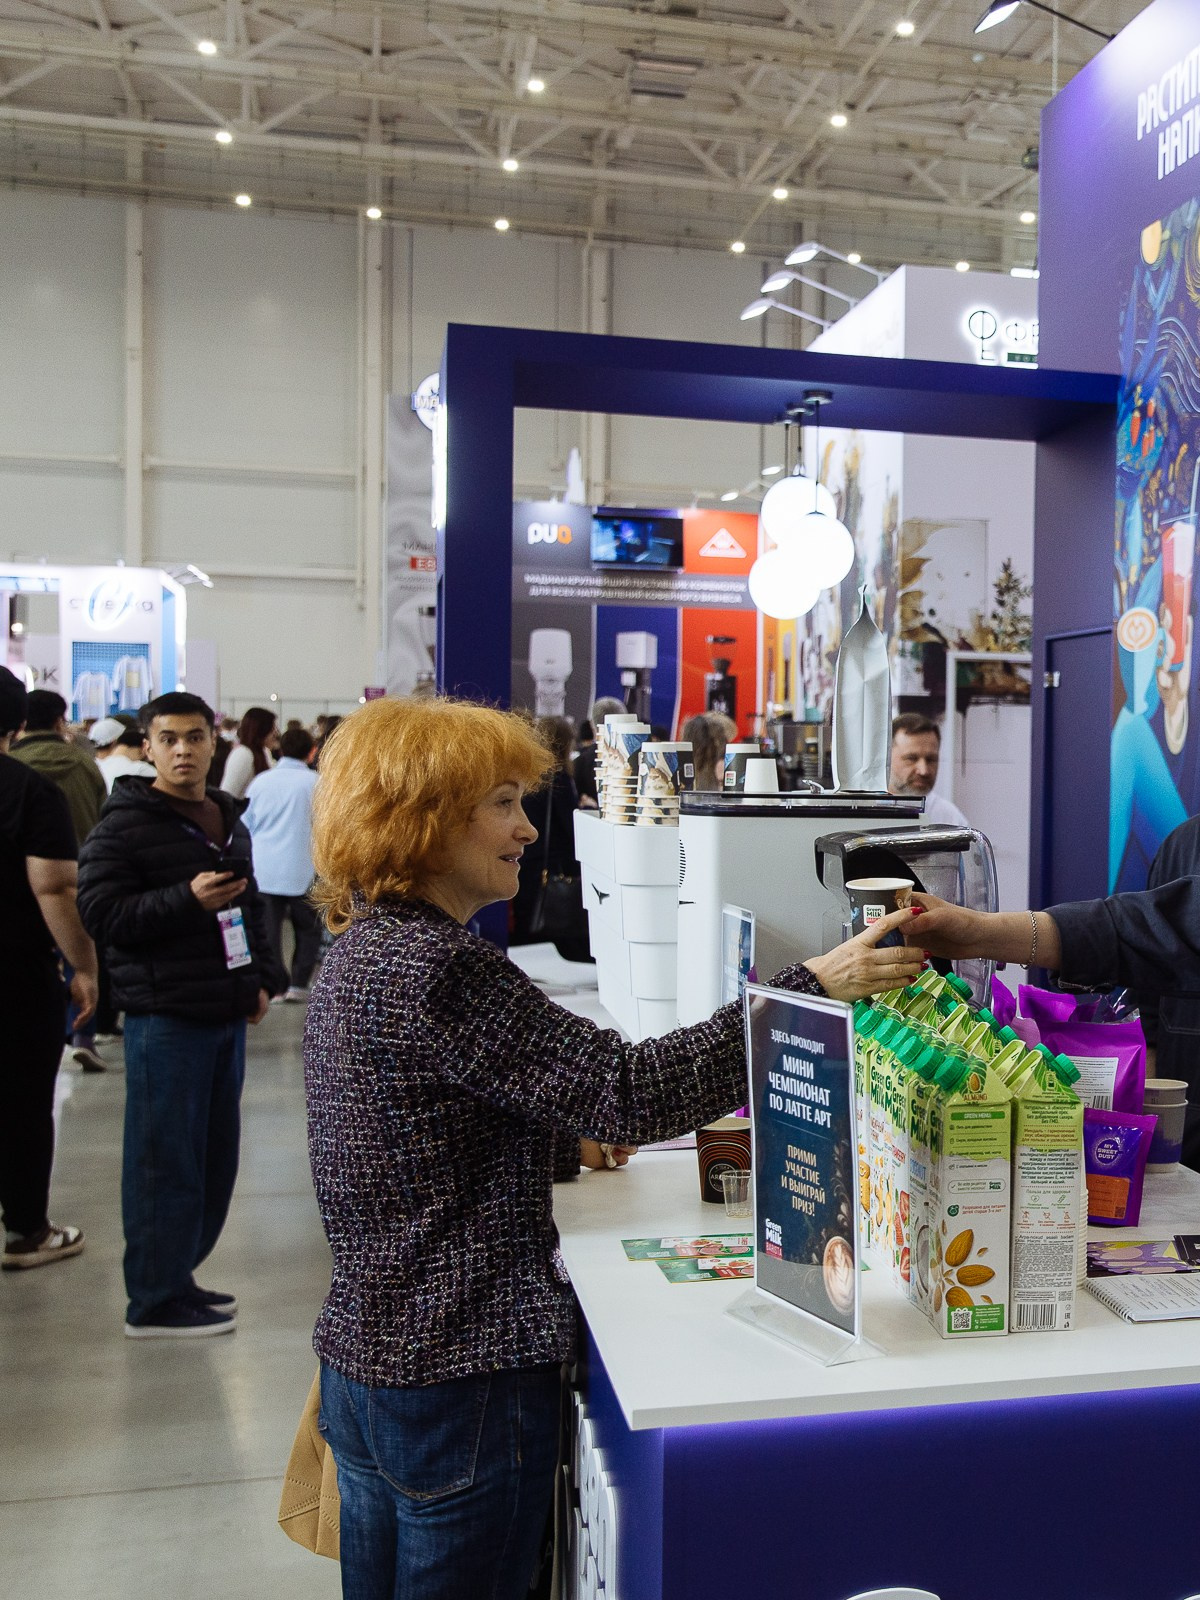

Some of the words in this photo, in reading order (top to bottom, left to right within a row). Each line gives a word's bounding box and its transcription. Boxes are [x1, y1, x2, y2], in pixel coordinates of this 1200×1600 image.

[771, 1028, 790, 1045] ЗДЕСЬ
[790, 1034, 825, 1055] ПРОХОДИТ
[782, 1054, 814, 1080] МИНИ
[871, 1066, 884, 1085] Green
[768, 1071, 831, 1107] ЧЕМПИОНАТ
[871, 1082, 885, 1109] Milk
[892, 1087, 906, 1107] Green
[963, 1093, 988, 1101] ALMOND
[769, 1093, 783, 1112] ПО
[784, 1098, 813, 1123] ЛАТТЕ
[814, 1108, 832, 1129] АРТ
[892, 1104, 906, 1133] Milk
[910, 1116, 928, 1148] Milk
[787, 1144, 817, 1168] ПРИМИ
[785, 1159, 820, 1186] УЧАСТИЕ
[781, 1174, 788, 1188] И
[789, 1177, 826, 1205] ВЫИГРАЙ
[792, 1195, 815, 1217] ПРИЗ!
[765, 1218, 782, 1234] Green
[765, 1227, 782, 1246] Milk
